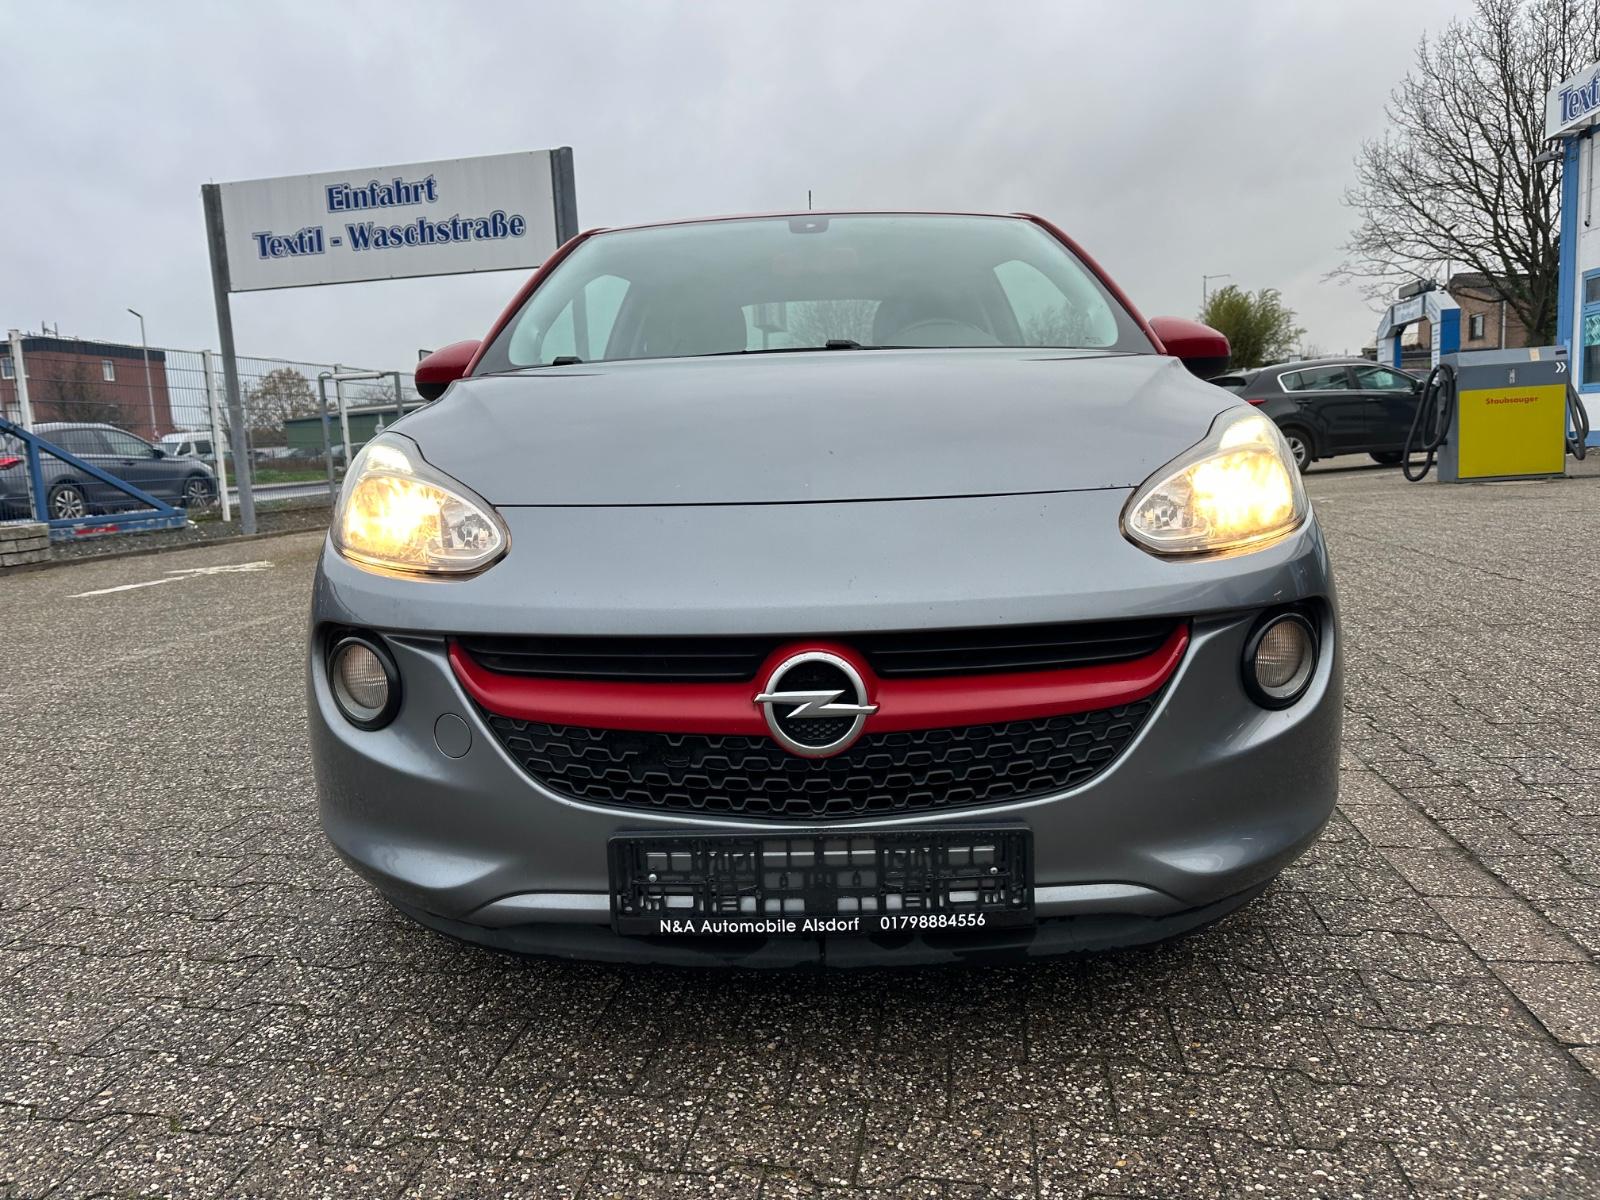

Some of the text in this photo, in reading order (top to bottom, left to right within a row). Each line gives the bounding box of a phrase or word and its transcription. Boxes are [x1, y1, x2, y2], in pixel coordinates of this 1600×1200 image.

[1558, 69, 1600, 126] Text
[325, 174, 438, 213] Einfahrt
[252, 226, 324, 259] Textil
[346, 210, 526, 250] Waschstraße
[1485, 396, 1539, 405] Staubsauger
[660, 913, 986, 933] N&A Automobile Alsdorf 01798884556
